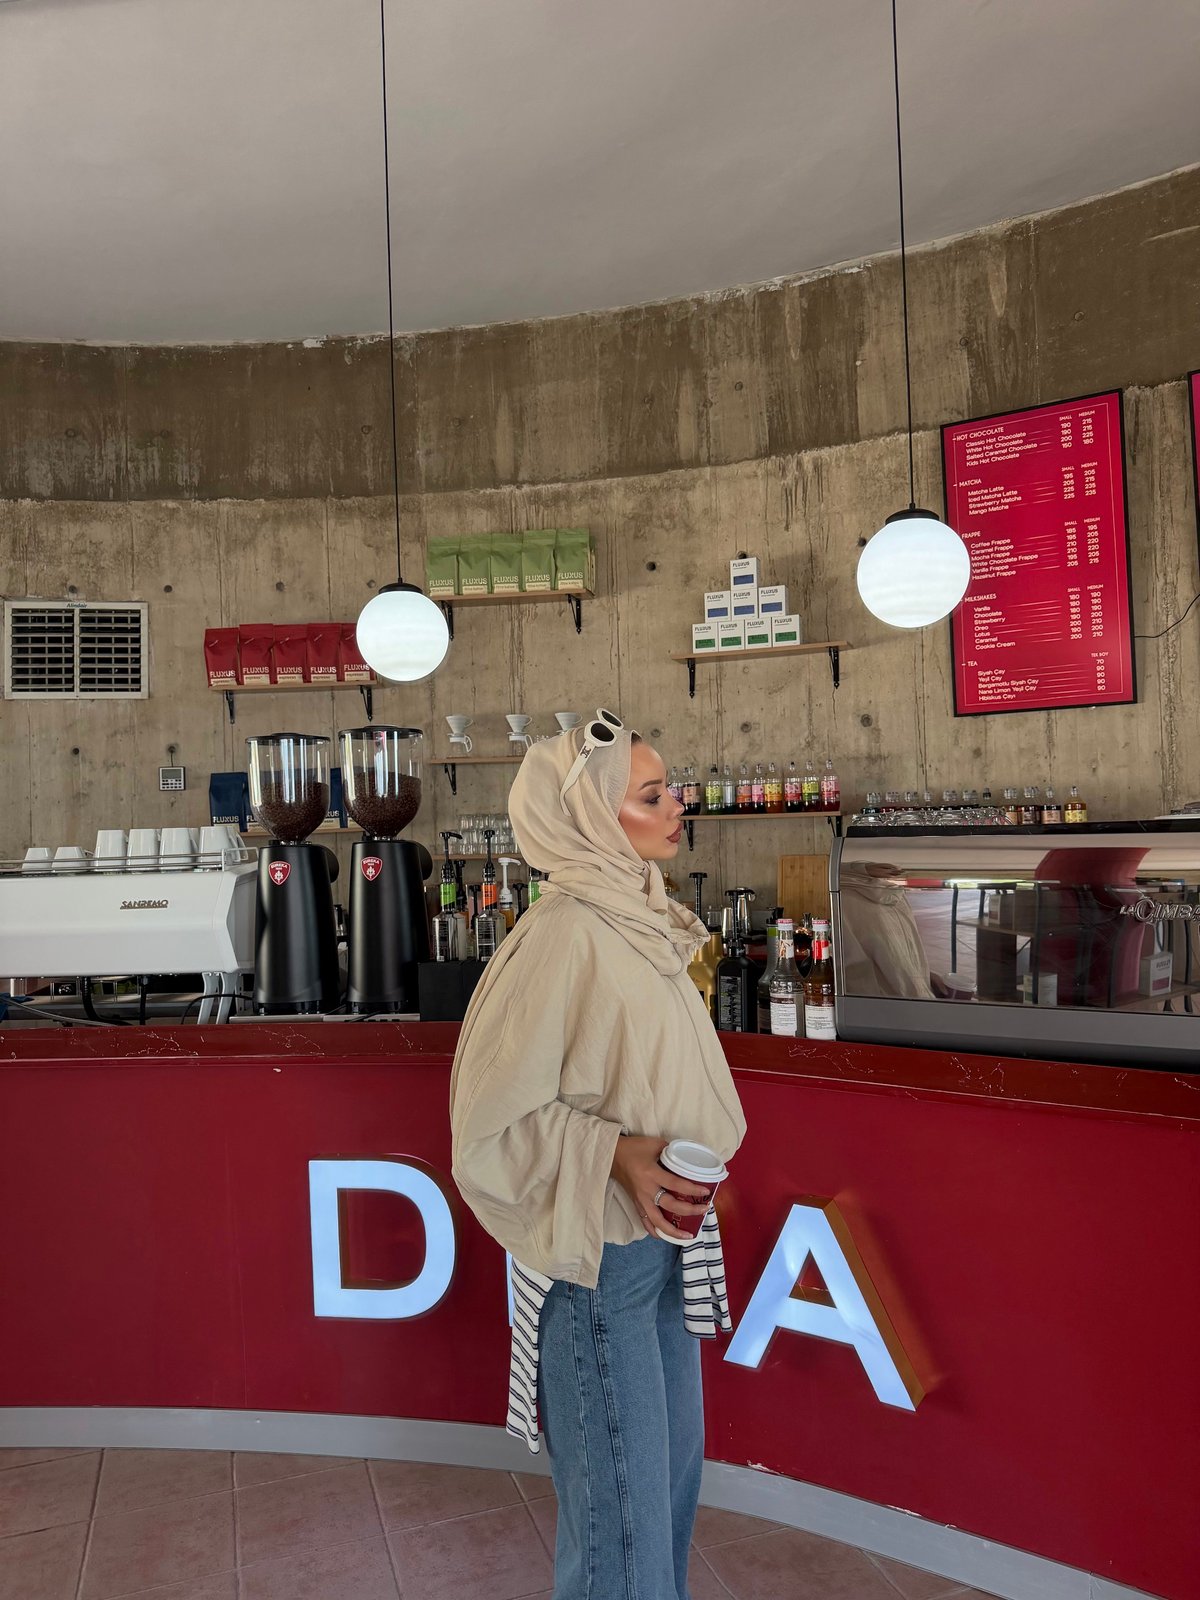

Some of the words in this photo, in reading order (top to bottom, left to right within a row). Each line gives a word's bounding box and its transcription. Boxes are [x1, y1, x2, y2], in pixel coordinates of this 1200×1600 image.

[969, 427, 1004, 439] CHOCOLATE
[998, 432, 1026, 441] Chocolate
[995, 439, 1023, 448] Chocolate
[985, 448, 1007, 456] Caramel
[1009, 443, 1037, 452] Chocolate
[991, 453, 1019, 462] Chocolate
[959, 479, 981, 487] MATCHA
[969, 500, 999, 509] Strawberry
[962, 531, 980, 539] FRAPPE
[989, 557, 1017, 565] Chocolate
[965, 593, 996, 602] MILKSHAKES
[974, 617, 1005, 625] Strawberry
[978, 681, 1009, 689] Bergamotlu
[120, 900, 168, 909] SANREMO
